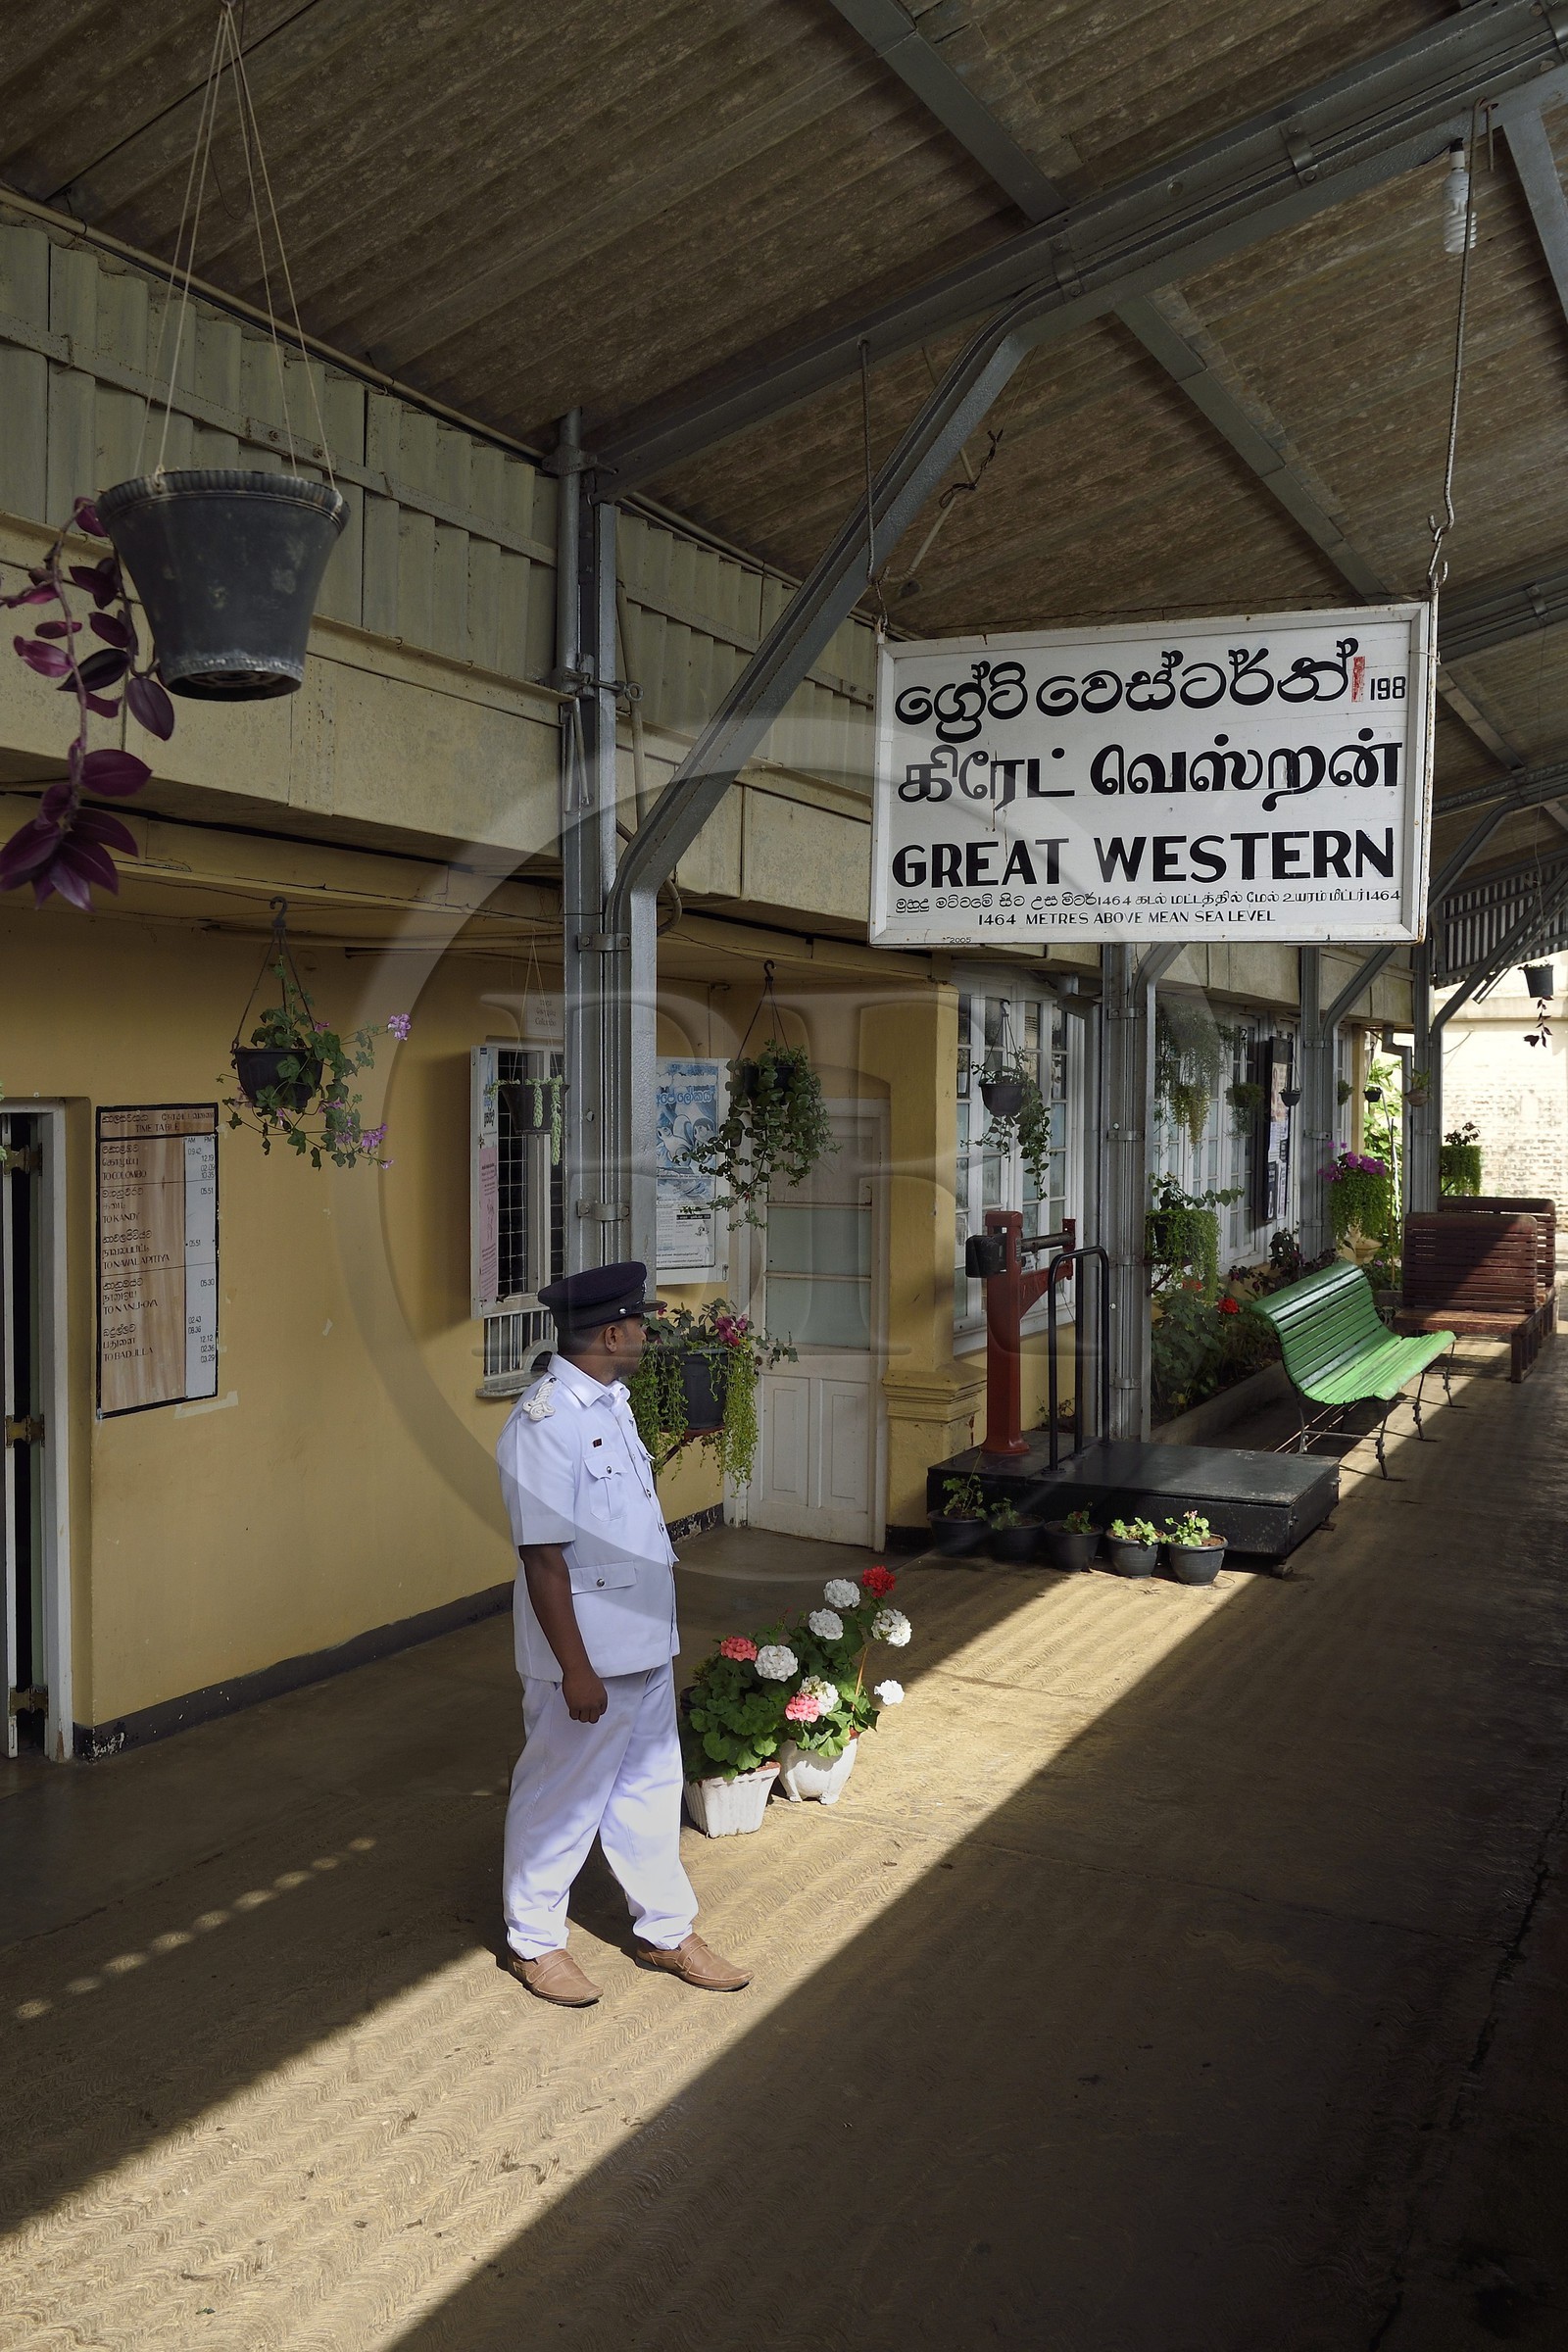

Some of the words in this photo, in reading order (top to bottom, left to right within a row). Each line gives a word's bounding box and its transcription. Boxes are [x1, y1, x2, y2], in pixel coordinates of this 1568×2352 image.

[1370, 676, 1406, 700] 198
[898, 745, 1075, 810] கிரேட்
[1090, 728, 1402, 811] வெஸ்றன்
[892, 838, 1069, 888] GREAT
[1093, 828, 1394, 883] WESTERN
[1136, 893, 1167, 905] கடல்
[1247, 891, 1279, 903] மேல்
[979, 913, 1016, 925] 1464
[1026, 912, 1089, 924] METRES
[1094, 911, 1143, 924] ABOVE
[1149, 911, 1189, 923] MEAN
[1195, 910, 1224, 922] SEA
[1228, 909, 1275, 922] LEVEL
